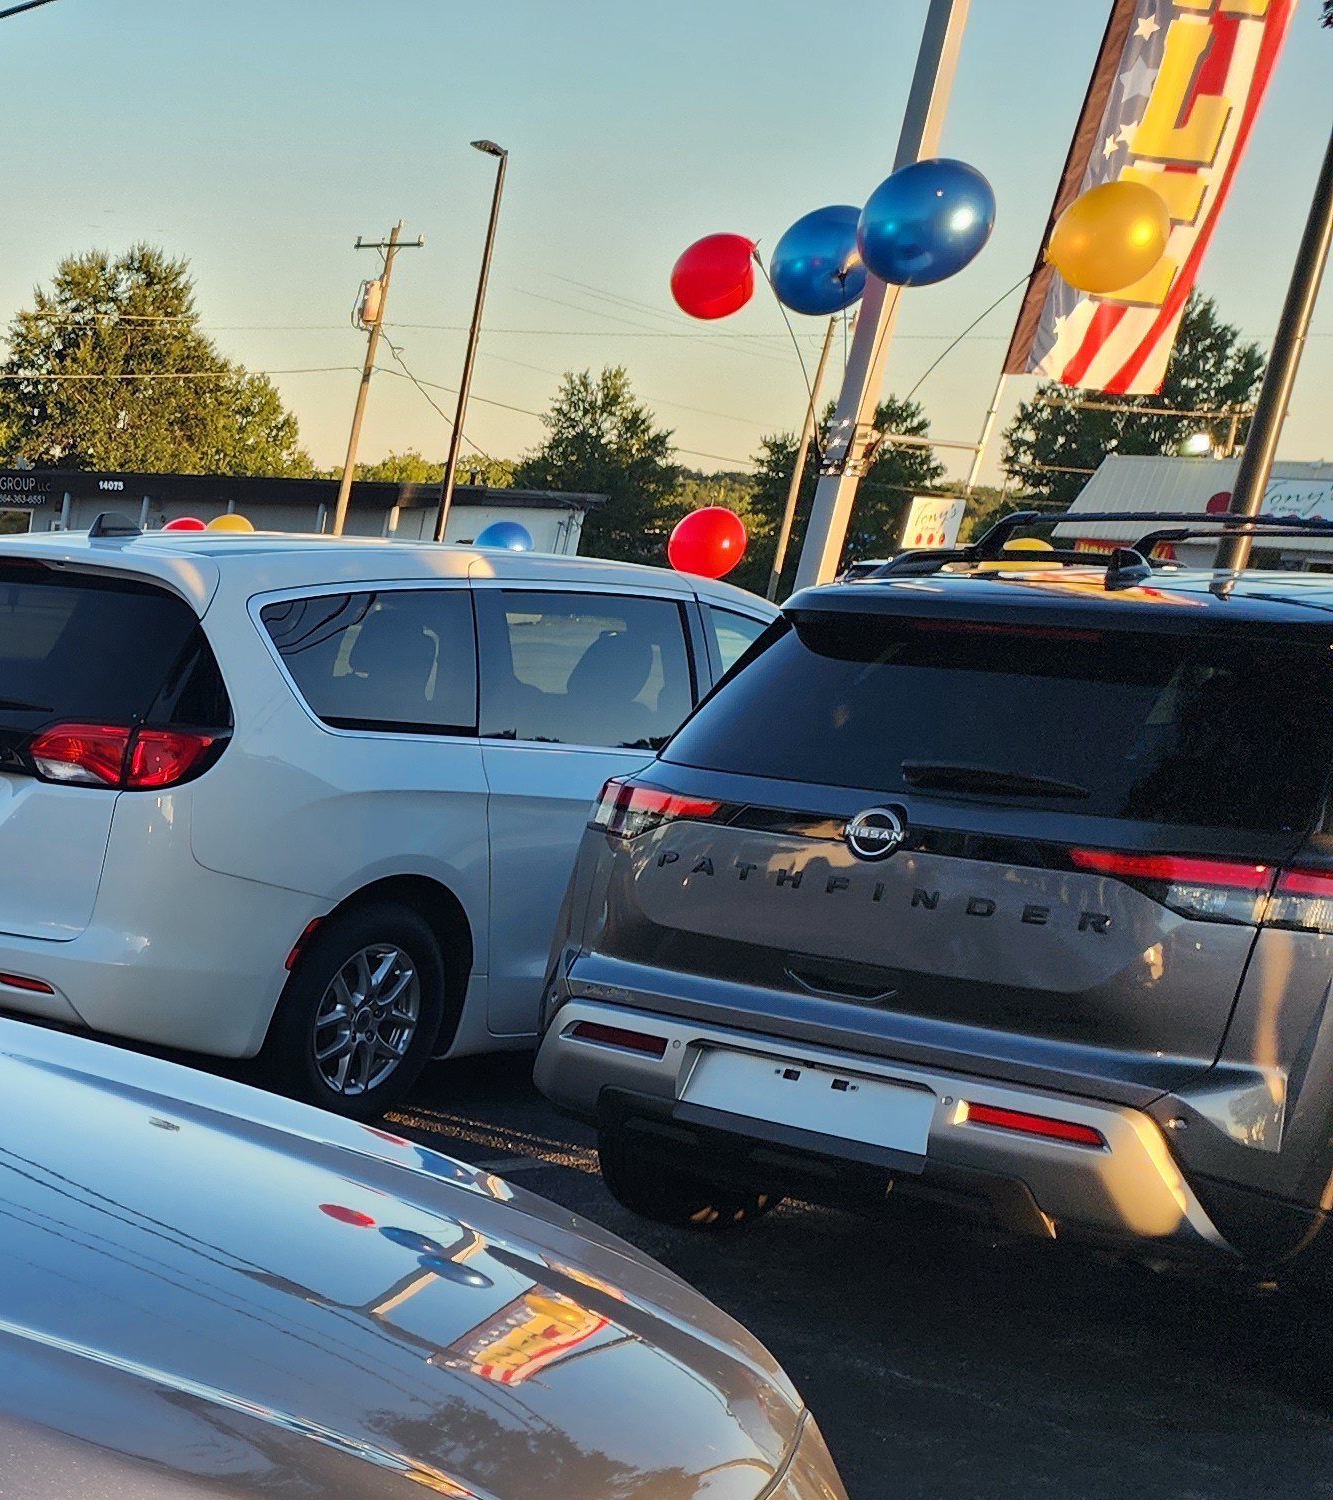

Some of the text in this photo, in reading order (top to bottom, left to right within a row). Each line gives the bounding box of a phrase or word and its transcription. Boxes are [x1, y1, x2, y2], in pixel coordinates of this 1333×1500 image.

[37, 482, 51, 492] LLC
[98, 480, 124, 491] 14075
[915, 502, 957, 534] Tony's
[845, 824, 905, 842] NISSAN
[656, 850, 1112, 935] PATHFINDER
